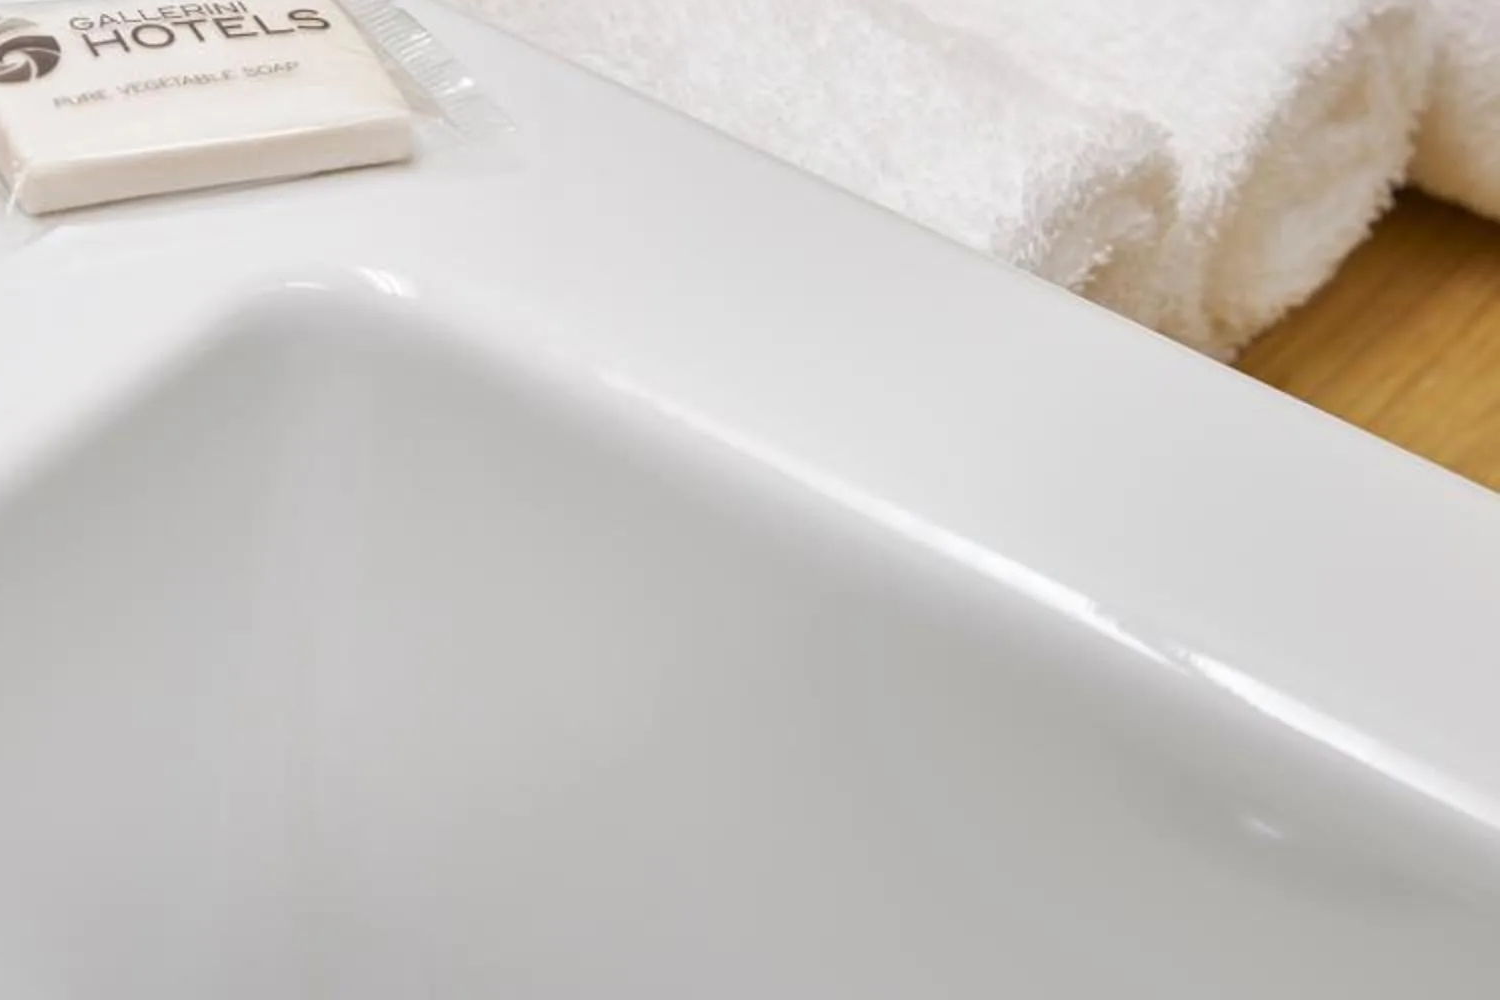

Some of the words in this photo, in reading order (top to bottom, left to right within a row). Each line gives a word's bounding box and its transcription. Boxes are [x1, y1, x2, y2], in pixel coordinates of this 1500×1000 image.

[69, 0, 248, 31] GALLERINI
[81, 9, 331, 58] HOTELS
[52, 88, 107, 109] PURE
[116, 69, 233, 96] VEGETABLE
[242, 60, 299, 79] SOAP
